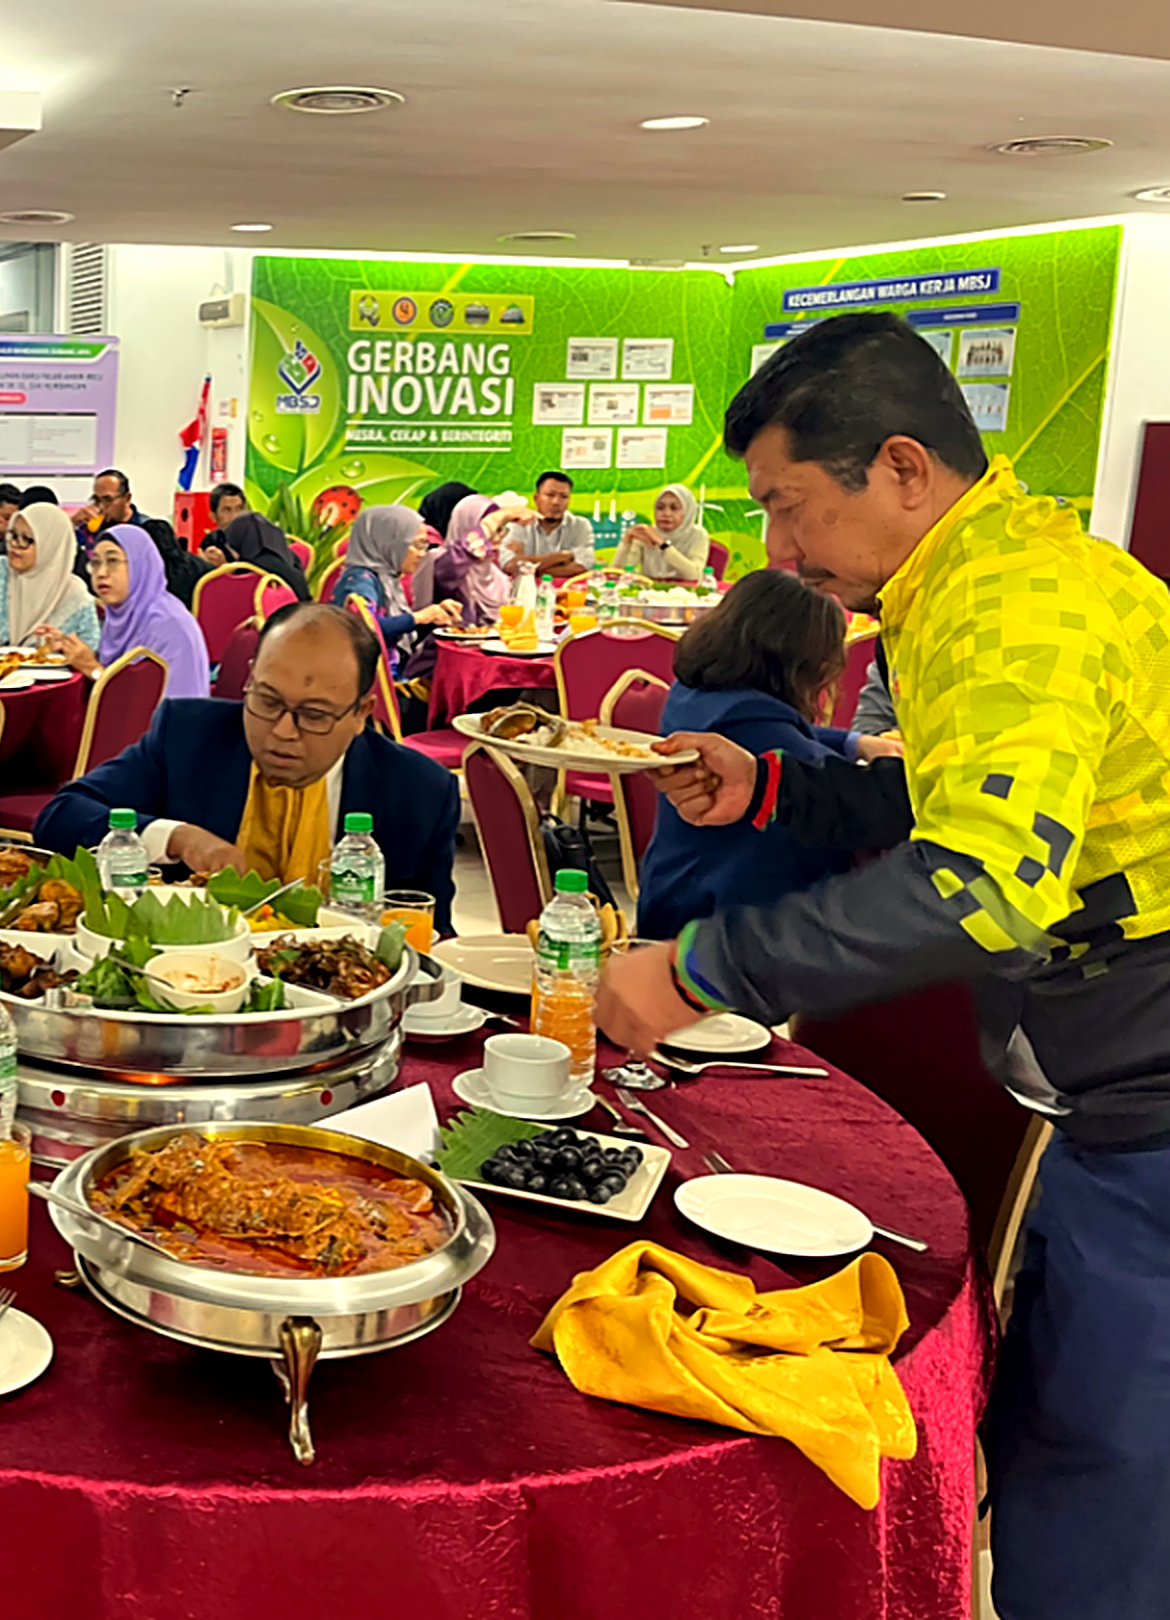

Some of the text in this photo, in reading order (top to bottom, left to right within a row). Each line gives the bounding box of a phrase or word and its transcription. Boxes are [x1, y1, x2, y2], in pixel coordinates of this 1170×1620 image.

[788, 274, 991, 307] KECEMERLANGAN WARGA KERJA MBSJ
[347, 340, 510, 376] GERBANG
[277, 395, 321, 409] MBSJ
[347, 375, 514, 416] INOVASI
[389, 429, 427, 442] CEKAP
[430, 430, 438, 442] &
[441, 430, 513, 442] BERINTEGRITI
